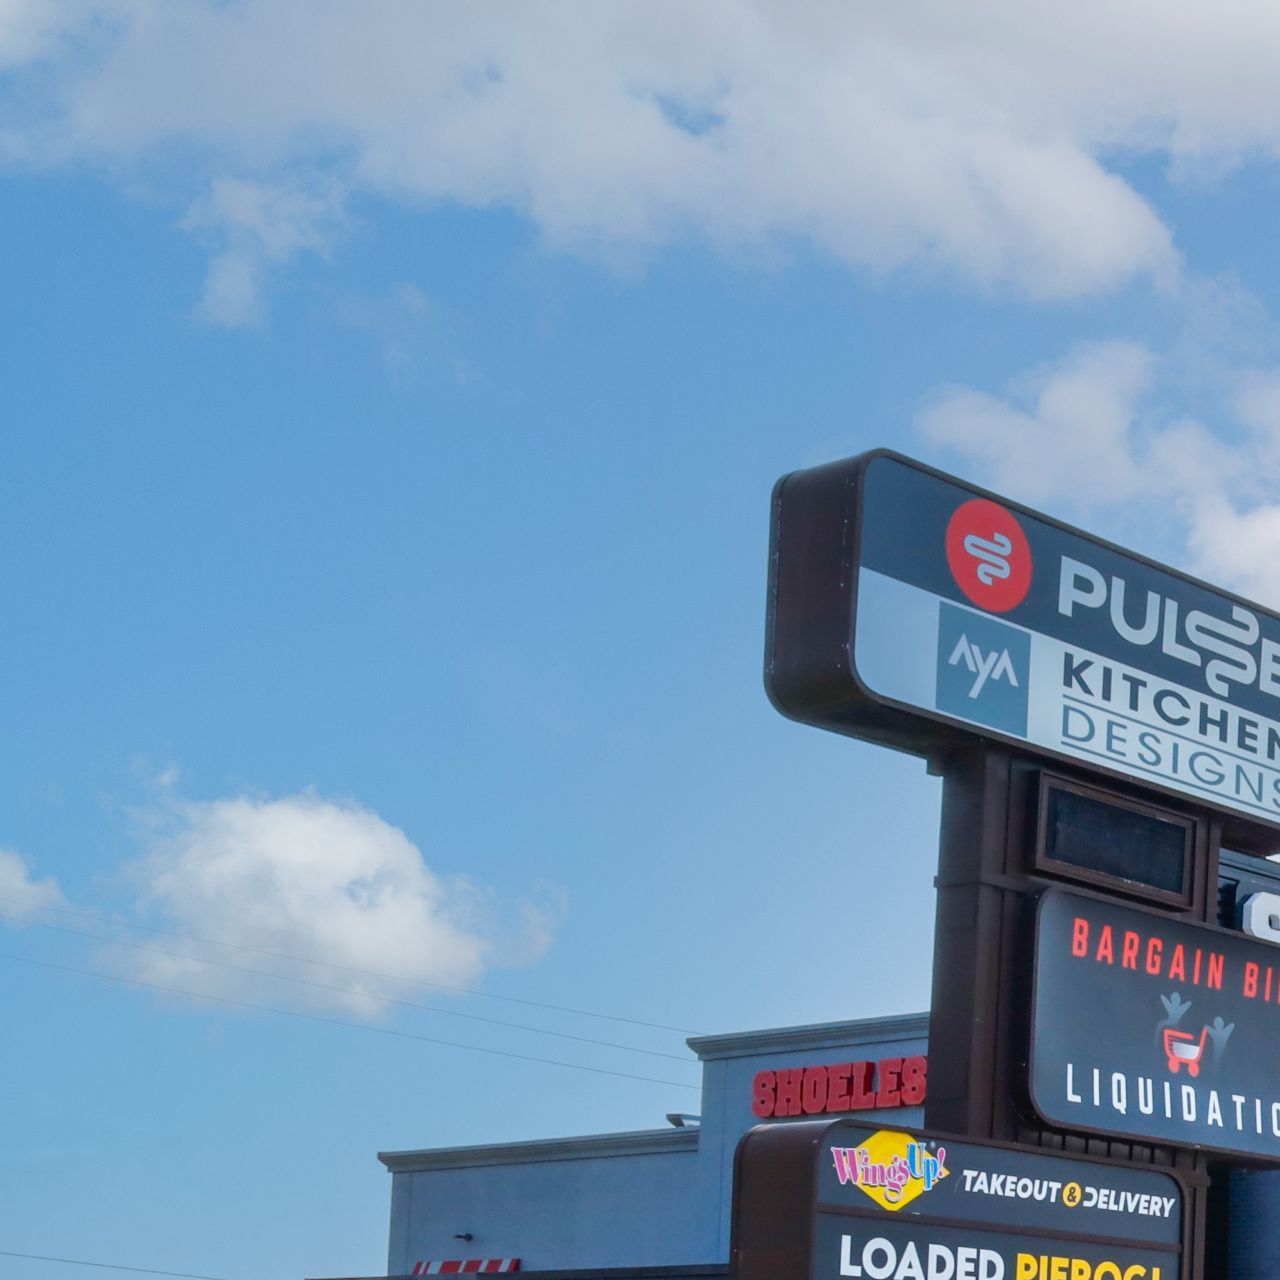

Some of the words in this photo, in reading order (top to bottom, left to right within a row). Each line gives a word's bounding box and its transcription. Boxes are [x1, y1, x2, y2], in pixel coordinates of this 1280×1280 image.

[1072, 917, 1225, 990] BARGAIN
[752, 1056, 928, 1118] SHOELES
[962, 1169, 1061, 1203] TAKEOUT
[1082, 1186, 1176, 1217] DELIVERY
